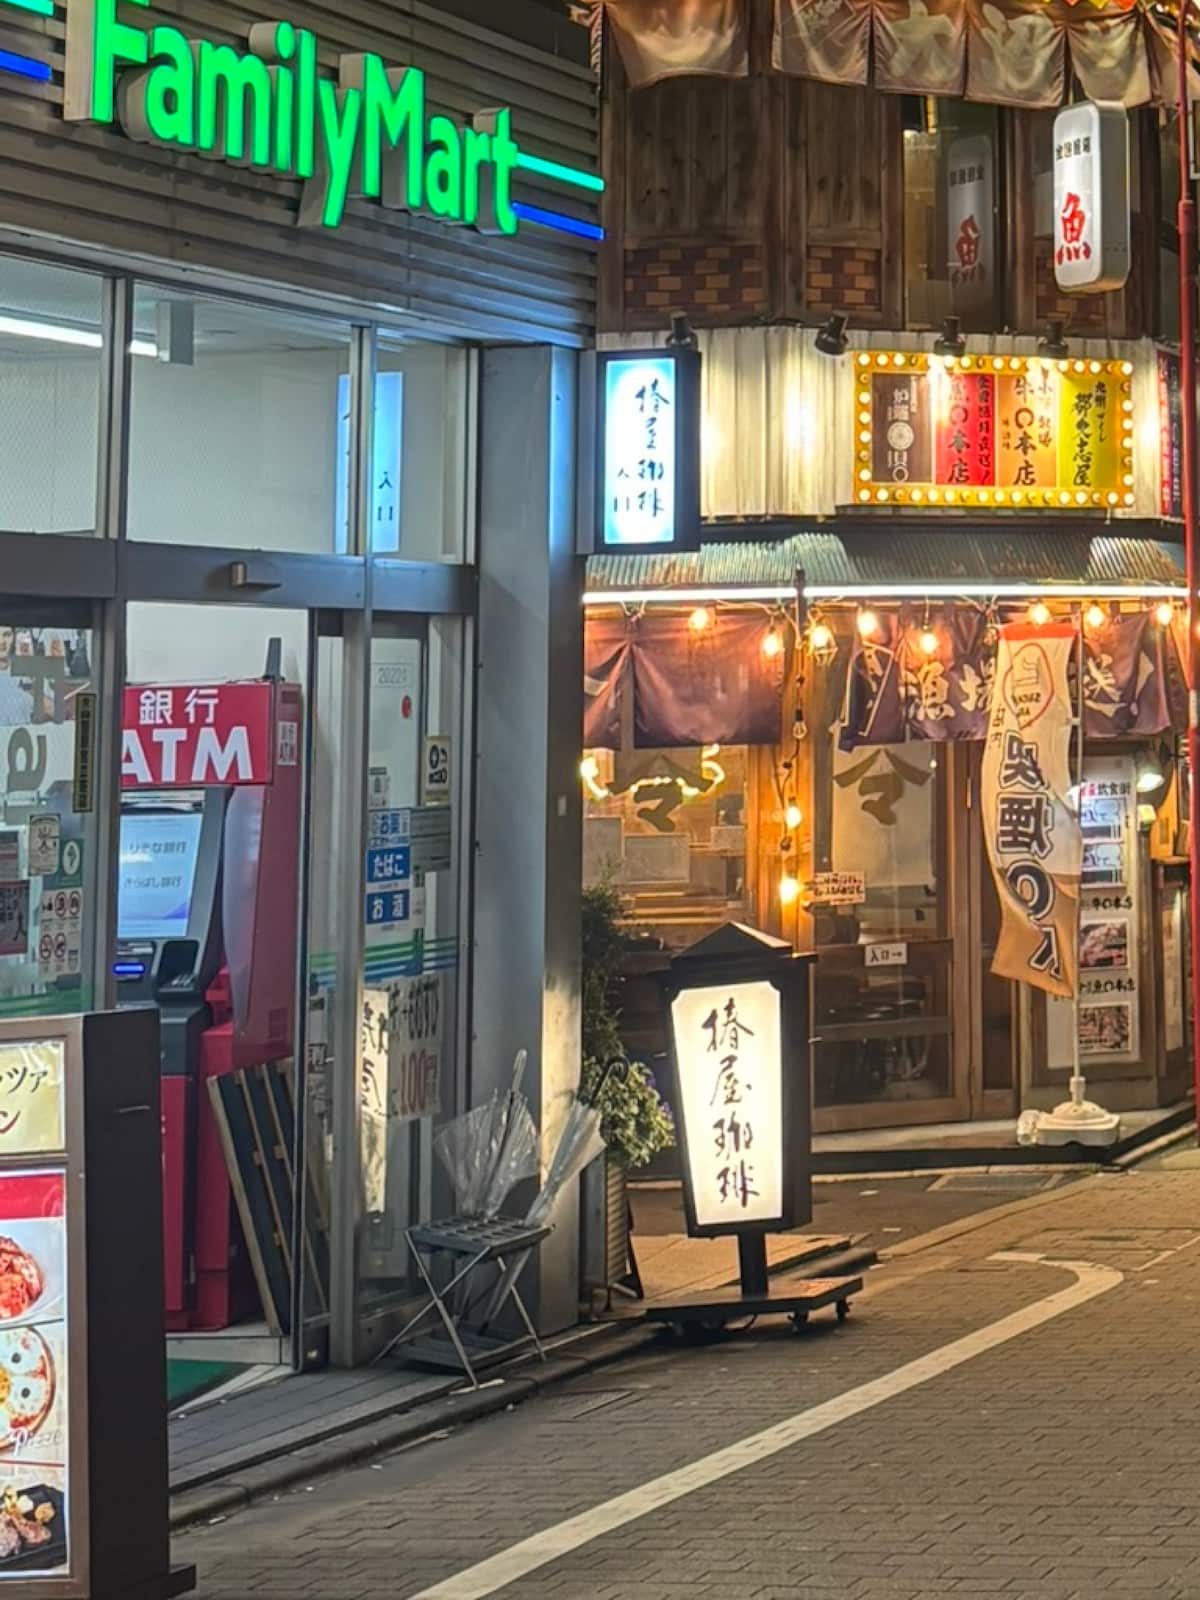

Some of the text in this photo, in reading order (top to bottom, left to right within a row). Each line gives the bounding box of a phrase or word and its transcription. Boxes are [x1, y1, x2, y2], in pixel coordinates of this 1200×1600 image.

[1056, 192, 1092, 266] 魚
[139, 688, 219, 726] 銀行
[121, 726, 254, 783] ATM
[0, 1066, 48, 1094] ツァ
[701, 998, 760, 1208] 椿屋珈琲
